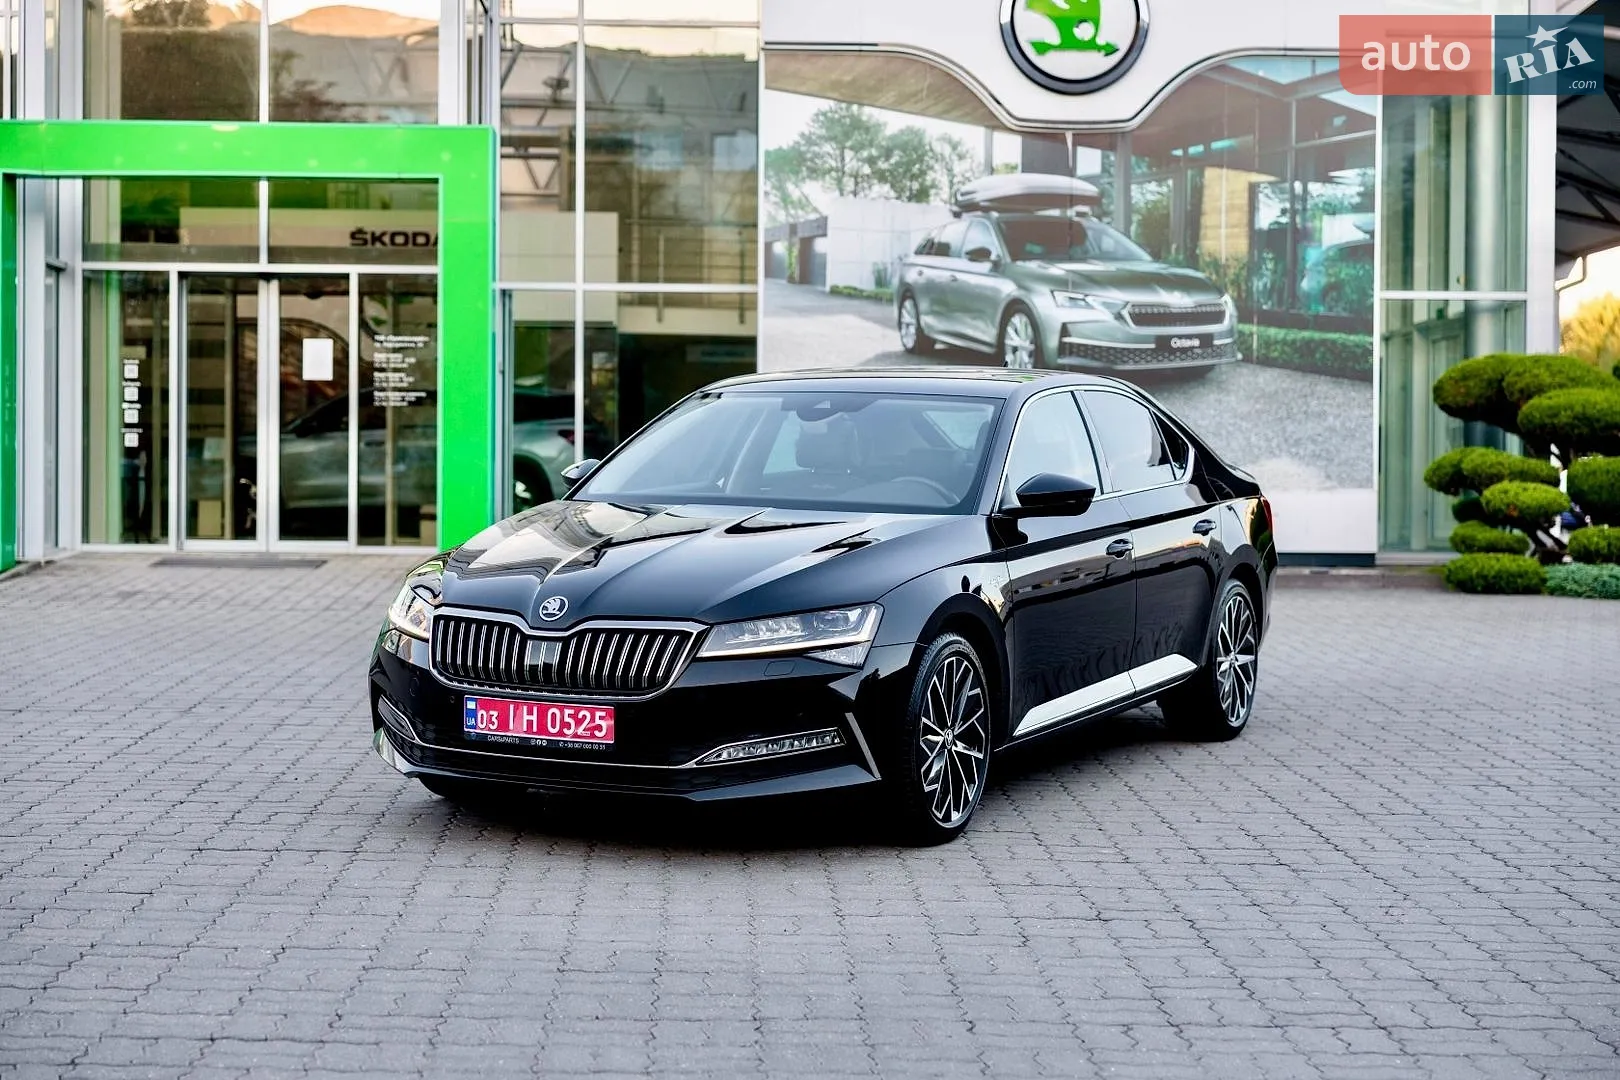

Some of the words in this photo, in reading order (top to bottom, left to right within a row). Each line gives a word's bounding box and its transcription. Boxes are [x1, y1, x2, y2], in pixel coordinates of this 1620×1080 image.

[466, 717, 476, 726] UA
[477, 710, 499, 729] 03
[547, 707, 607, 738] 0525
